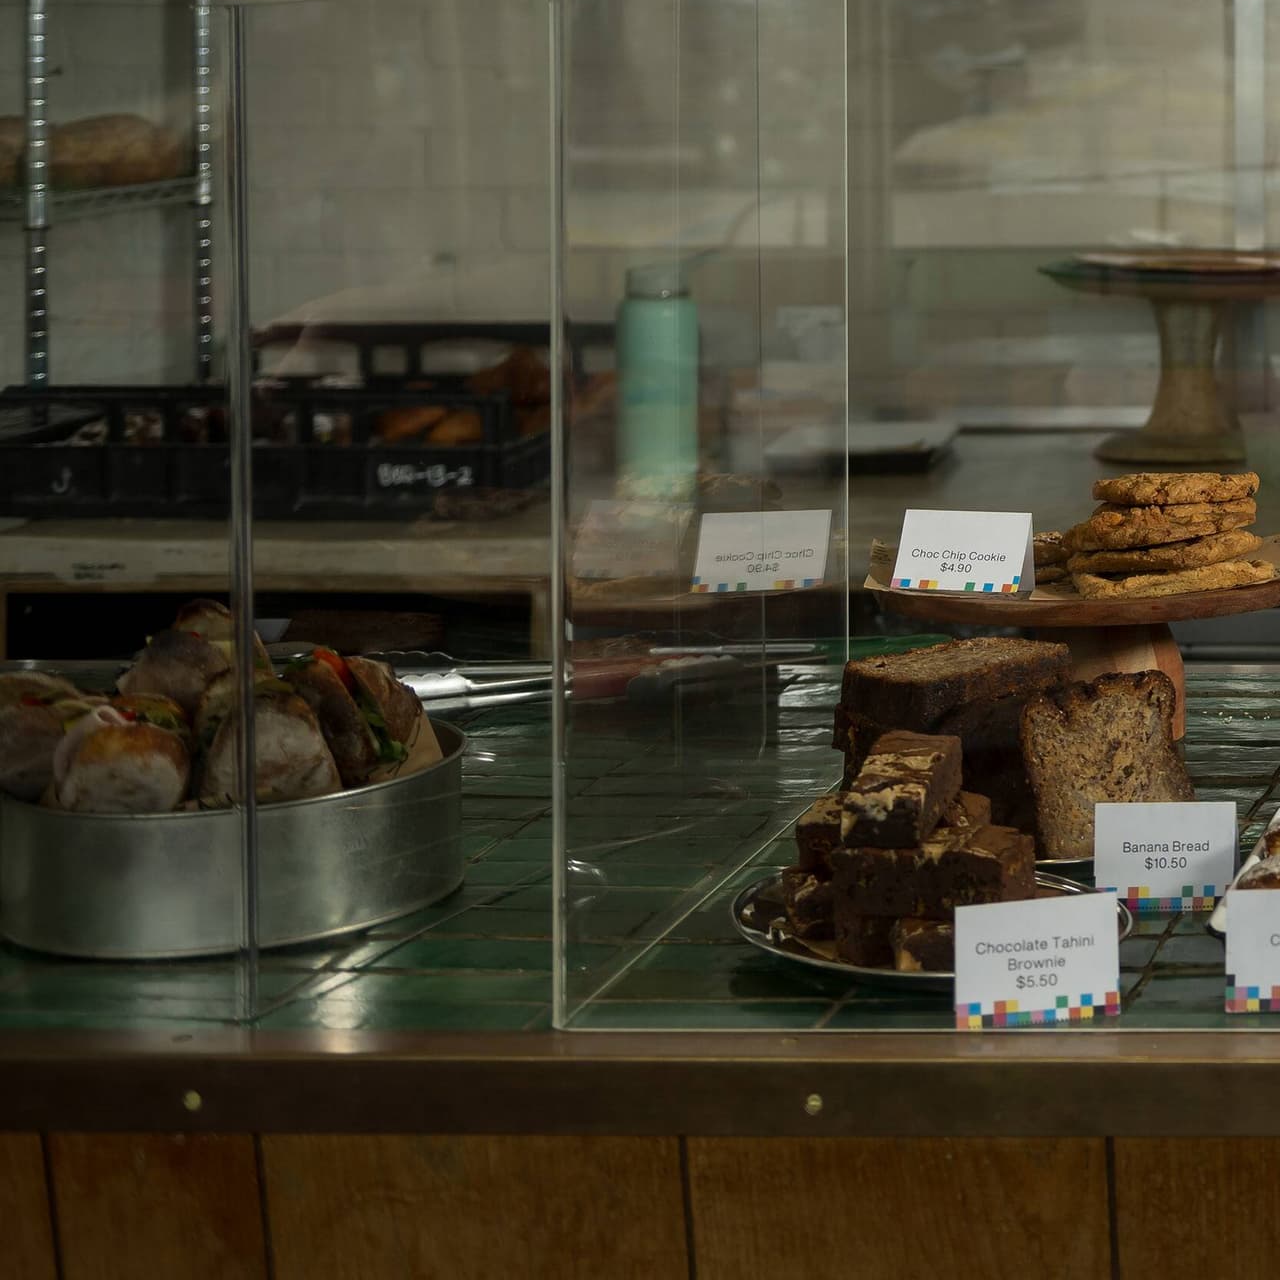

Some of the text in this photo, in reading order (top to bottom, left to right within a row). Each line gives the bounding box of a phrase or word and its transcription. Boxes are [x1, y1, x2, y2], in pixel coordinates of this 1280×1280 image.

[911, 548, 1006, 562] Choc Chip Cookie
[940, 562, 972, 574] $4.90
[1122, 840, 1210, 854] Banana Bread
[1144, 856, 1187, 870] $10.50
[975, 935, 1095, 955] Chocolate Tahini
[1007, 956, 1066, 971] Brownie
[1016, 973, 1058, 989] $5.50
